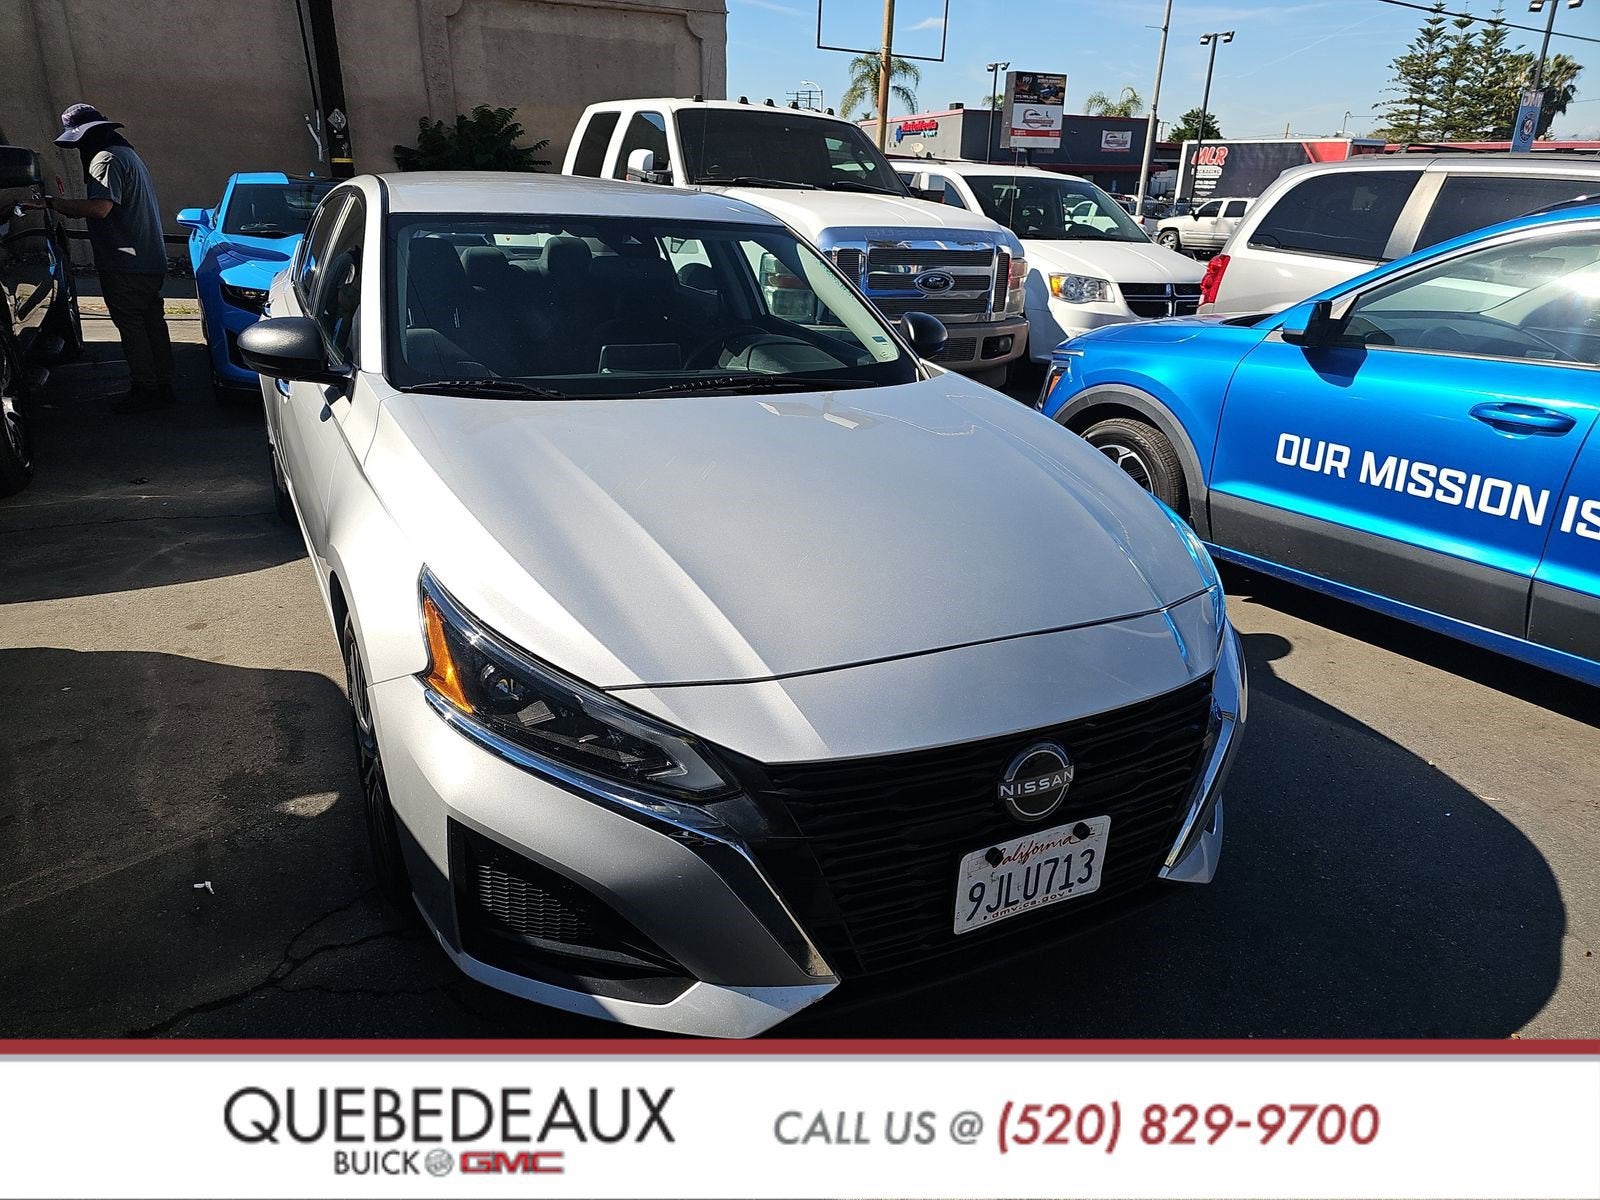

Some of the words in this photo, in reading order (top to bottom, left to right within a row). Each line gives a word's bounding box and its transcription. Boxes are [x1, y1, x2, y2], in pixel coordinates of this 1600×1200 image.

[1190, 146, 1228, 166] MLR
[1275, 432, 1351, 479] OUR
[1359, 451, 1550, 526] MISSION
[1560, 495, 1600, 541] IS
[999, 765, 1075, 798] NISSAN
[966, 848, 1096, 922] 9JLU713
[991, 891, 1066, 919] dmv.ca.gov
